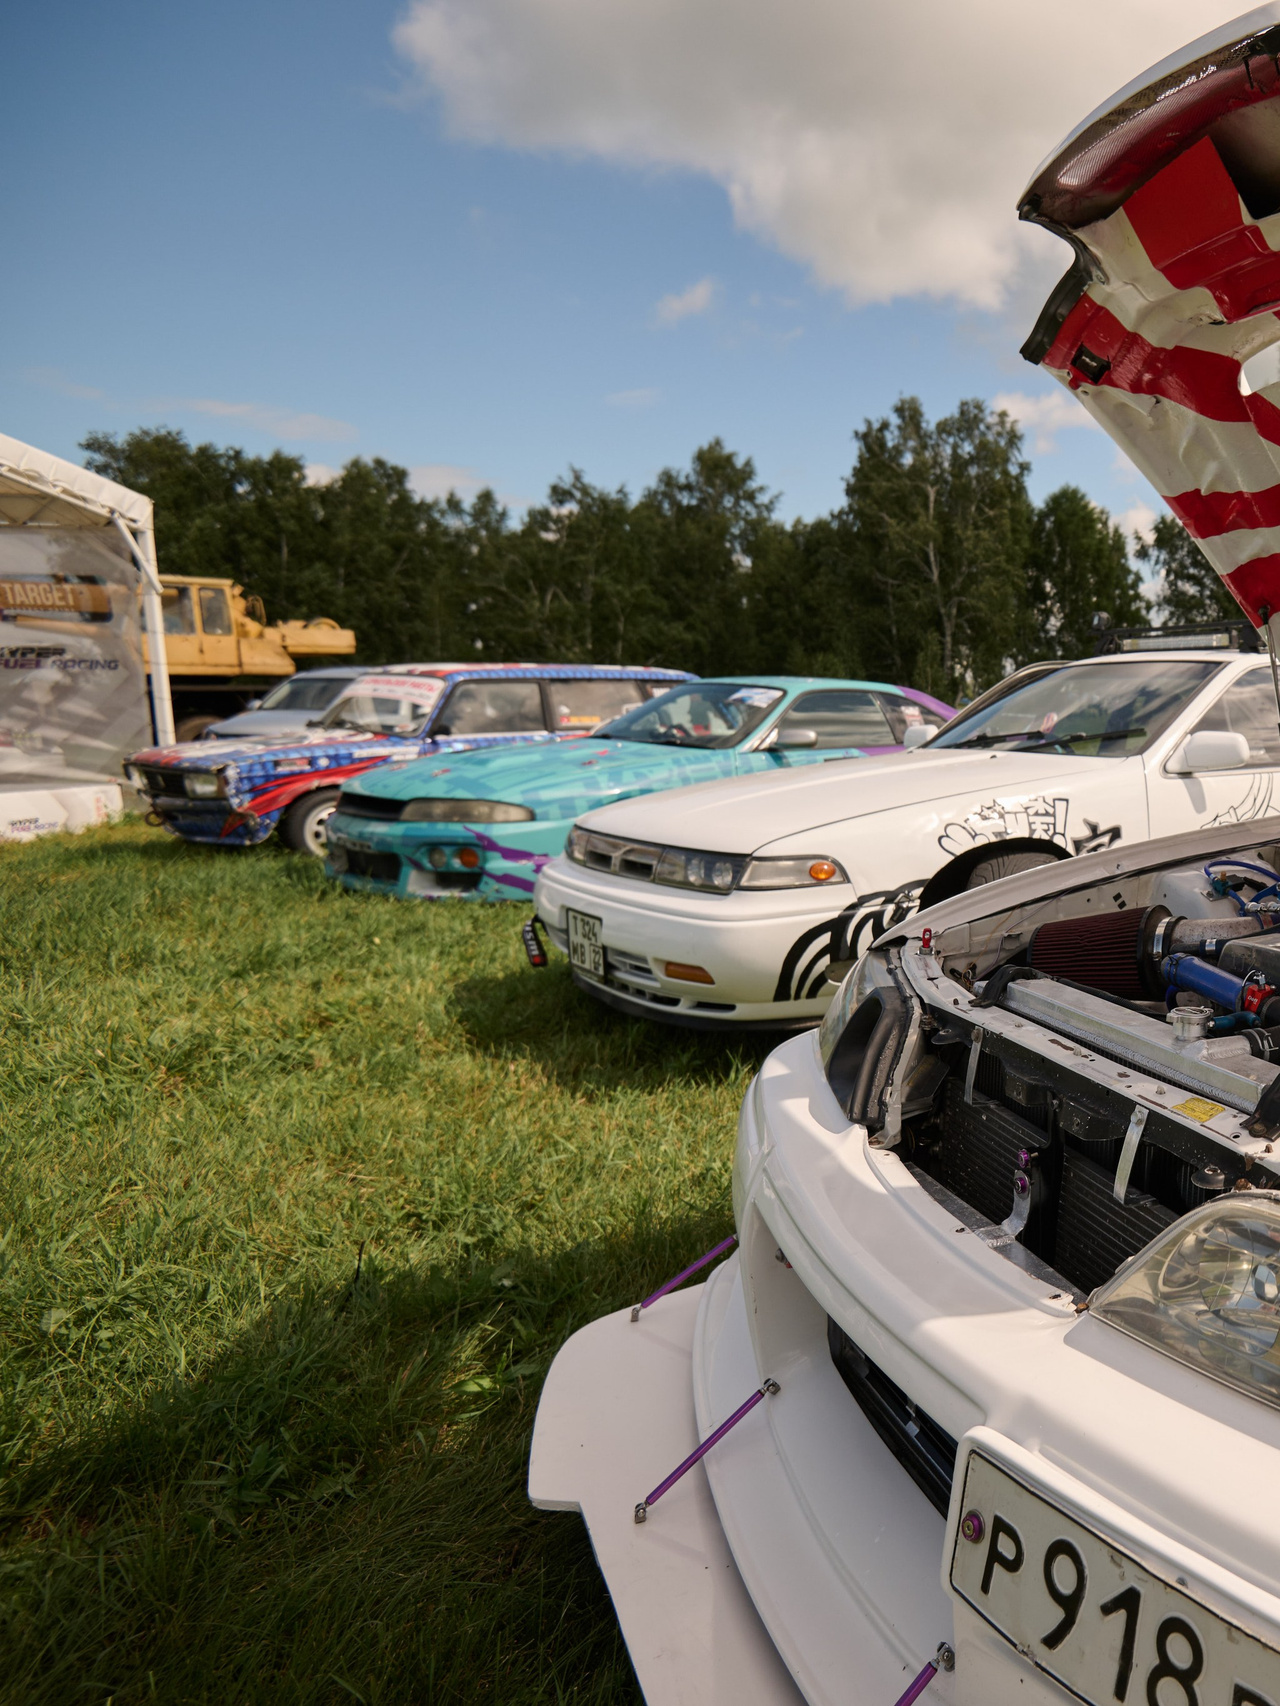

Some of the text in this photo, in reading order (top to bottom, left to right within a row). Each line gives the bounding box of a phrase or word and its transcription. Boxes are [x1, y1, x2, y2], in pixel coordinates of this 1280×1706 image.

[1, 583, 76, 606] TARGET
[0, 659, 119, 670] UEL RACING
